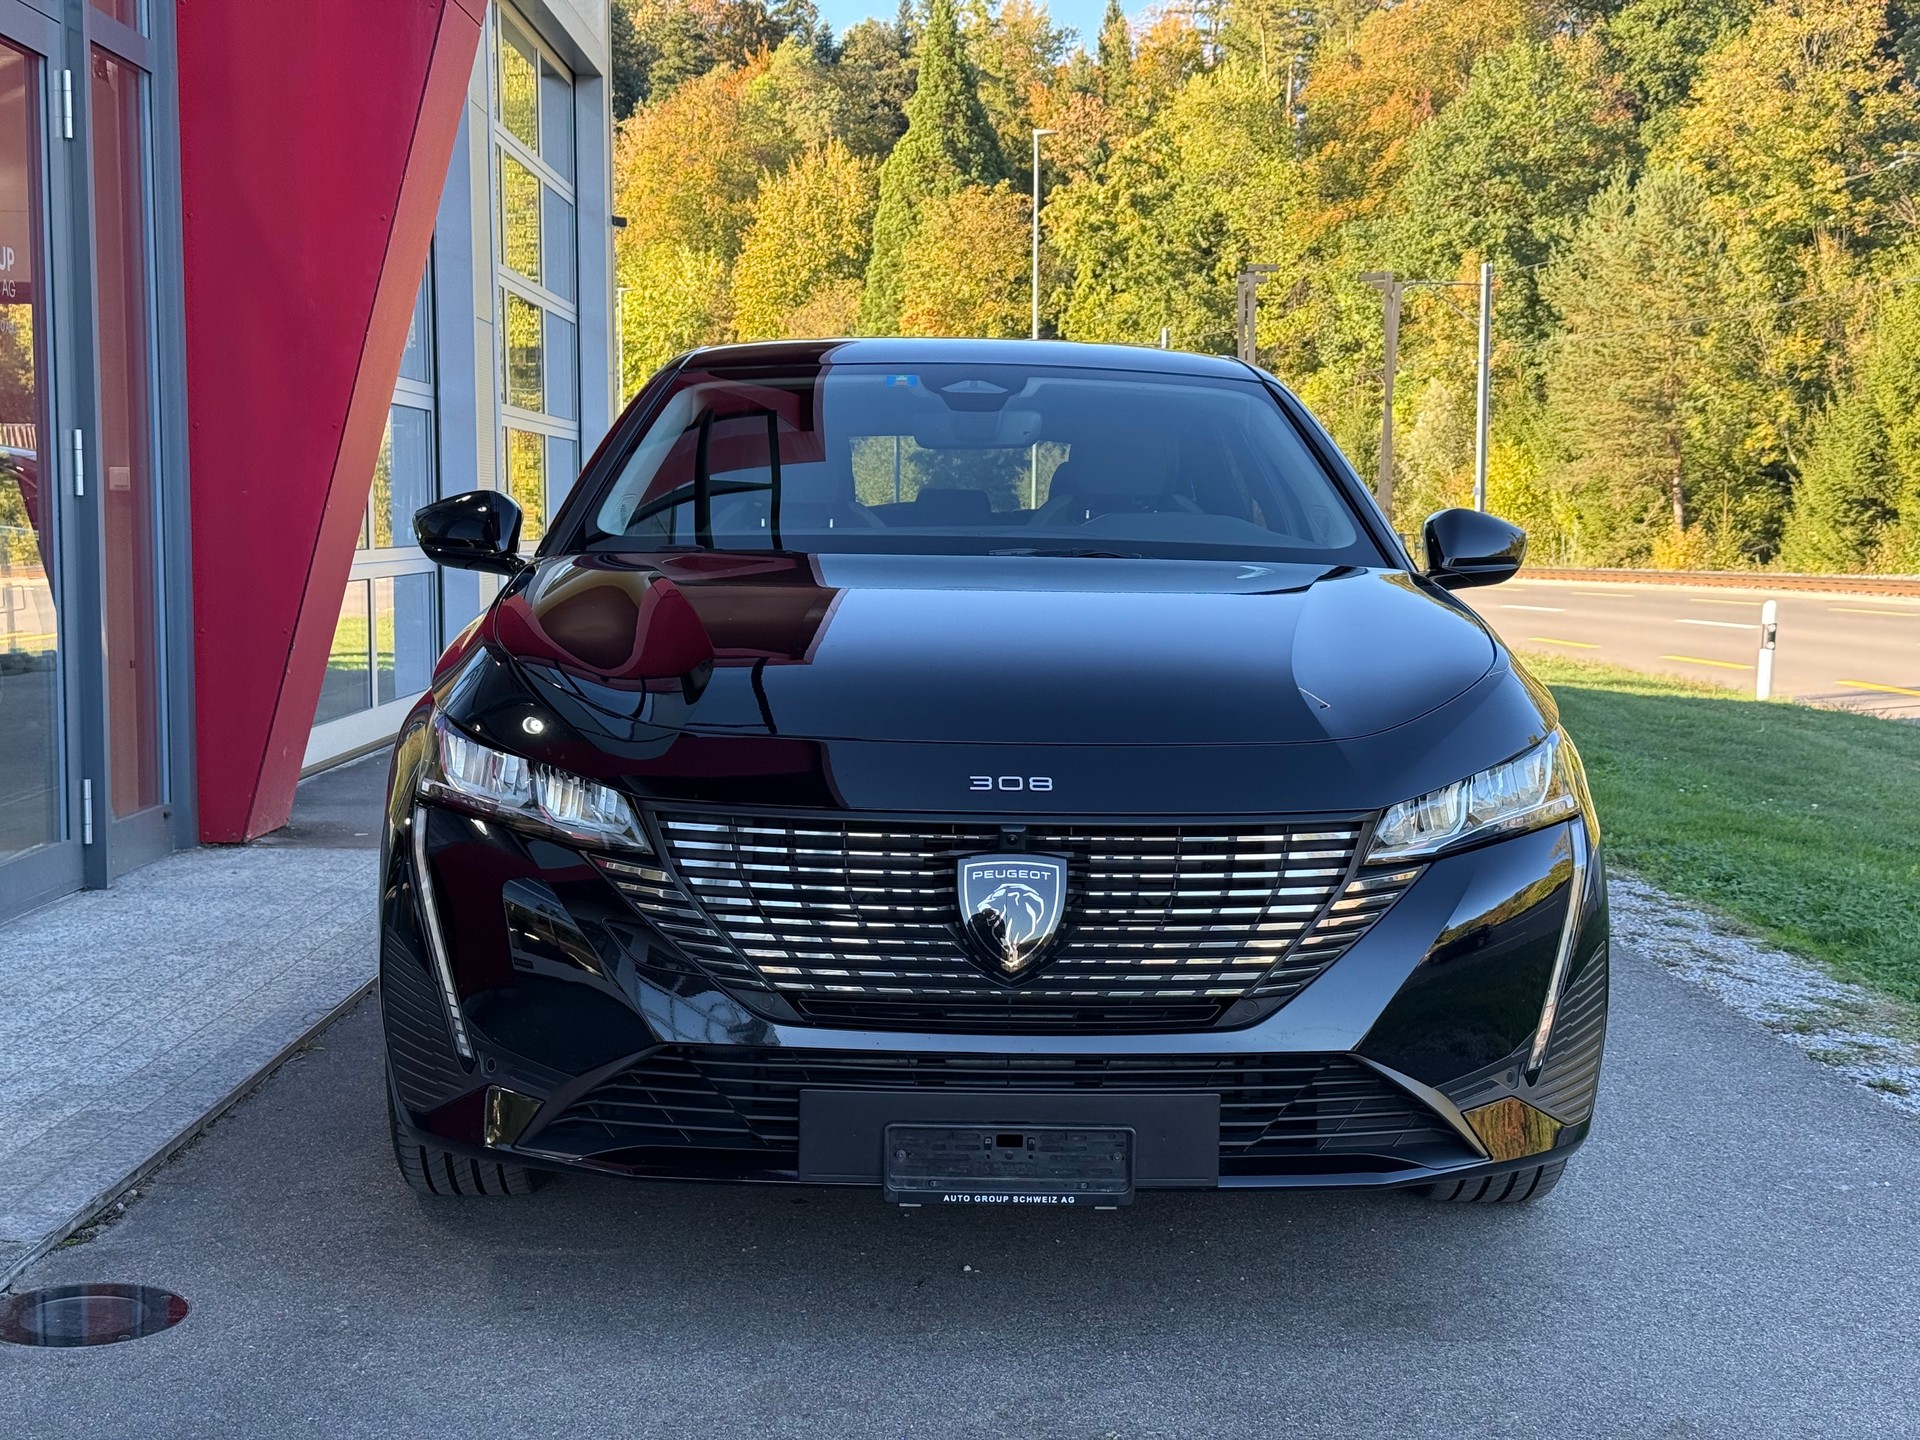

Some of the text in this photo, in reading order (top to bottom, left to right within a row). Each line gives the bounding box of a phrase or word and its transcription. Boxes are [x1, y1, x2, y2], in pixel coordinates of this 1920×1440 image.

[2, 279, 16, 298] AG
[969, 776, 1053, 791] 308
[972, 869, 1051, 880] PEUGEOT
[974, 1195, 1009, 1203] GROUP
[1013, 1196, 1057, 1204] SCHWEIZ
[1060, 1196, 1075, 1204] AG
